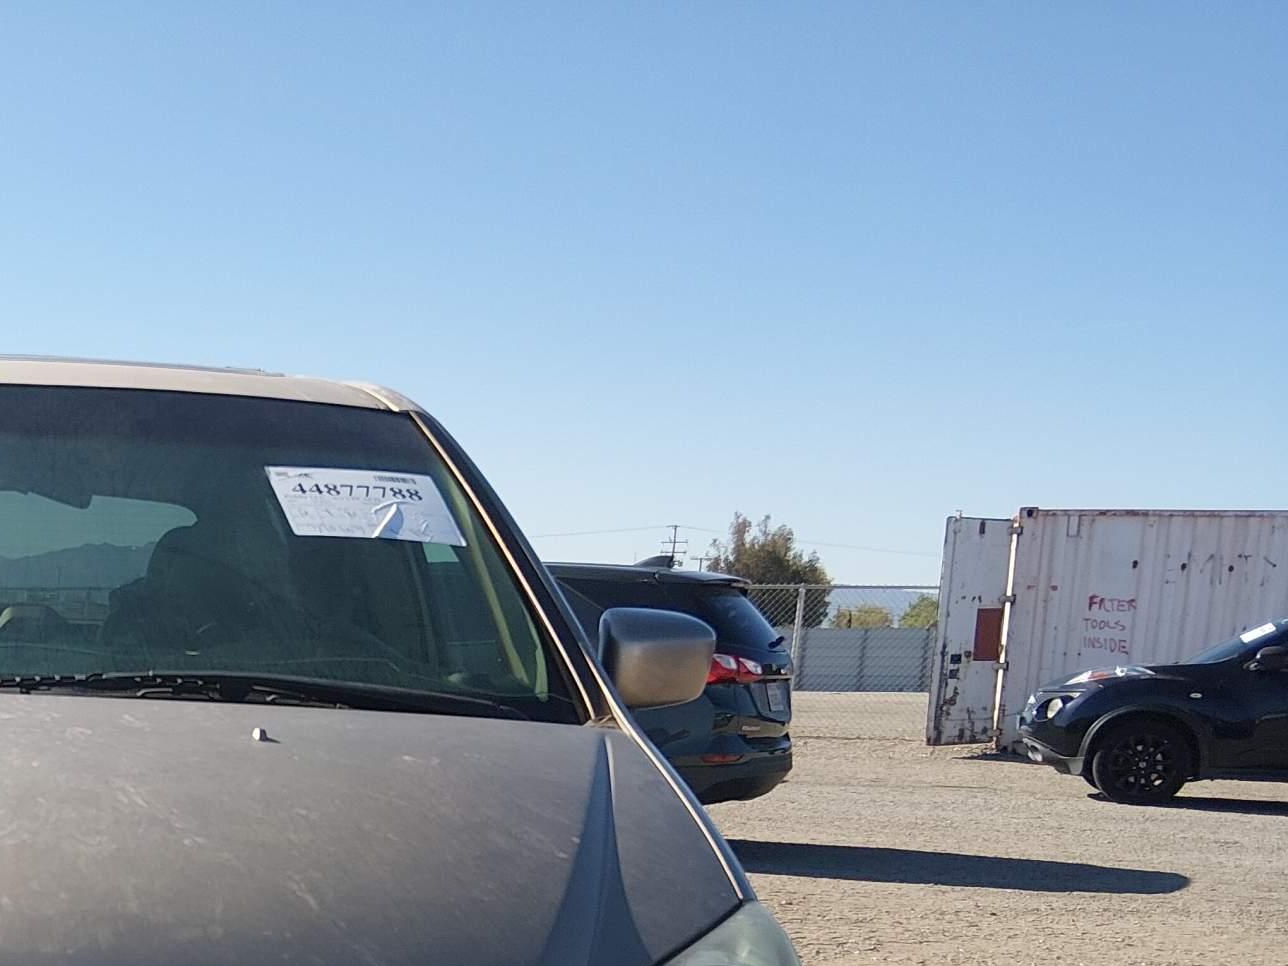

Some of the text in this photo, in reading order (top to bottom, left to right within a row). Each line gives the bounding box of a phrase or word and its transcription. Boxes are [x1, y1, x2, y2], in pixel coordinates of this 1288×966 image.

[292, 482, 424, 502] 44877788
[1083, 618, 1126, 632] TOOLS
[1083, 636, 1129, 655] INSIDE
